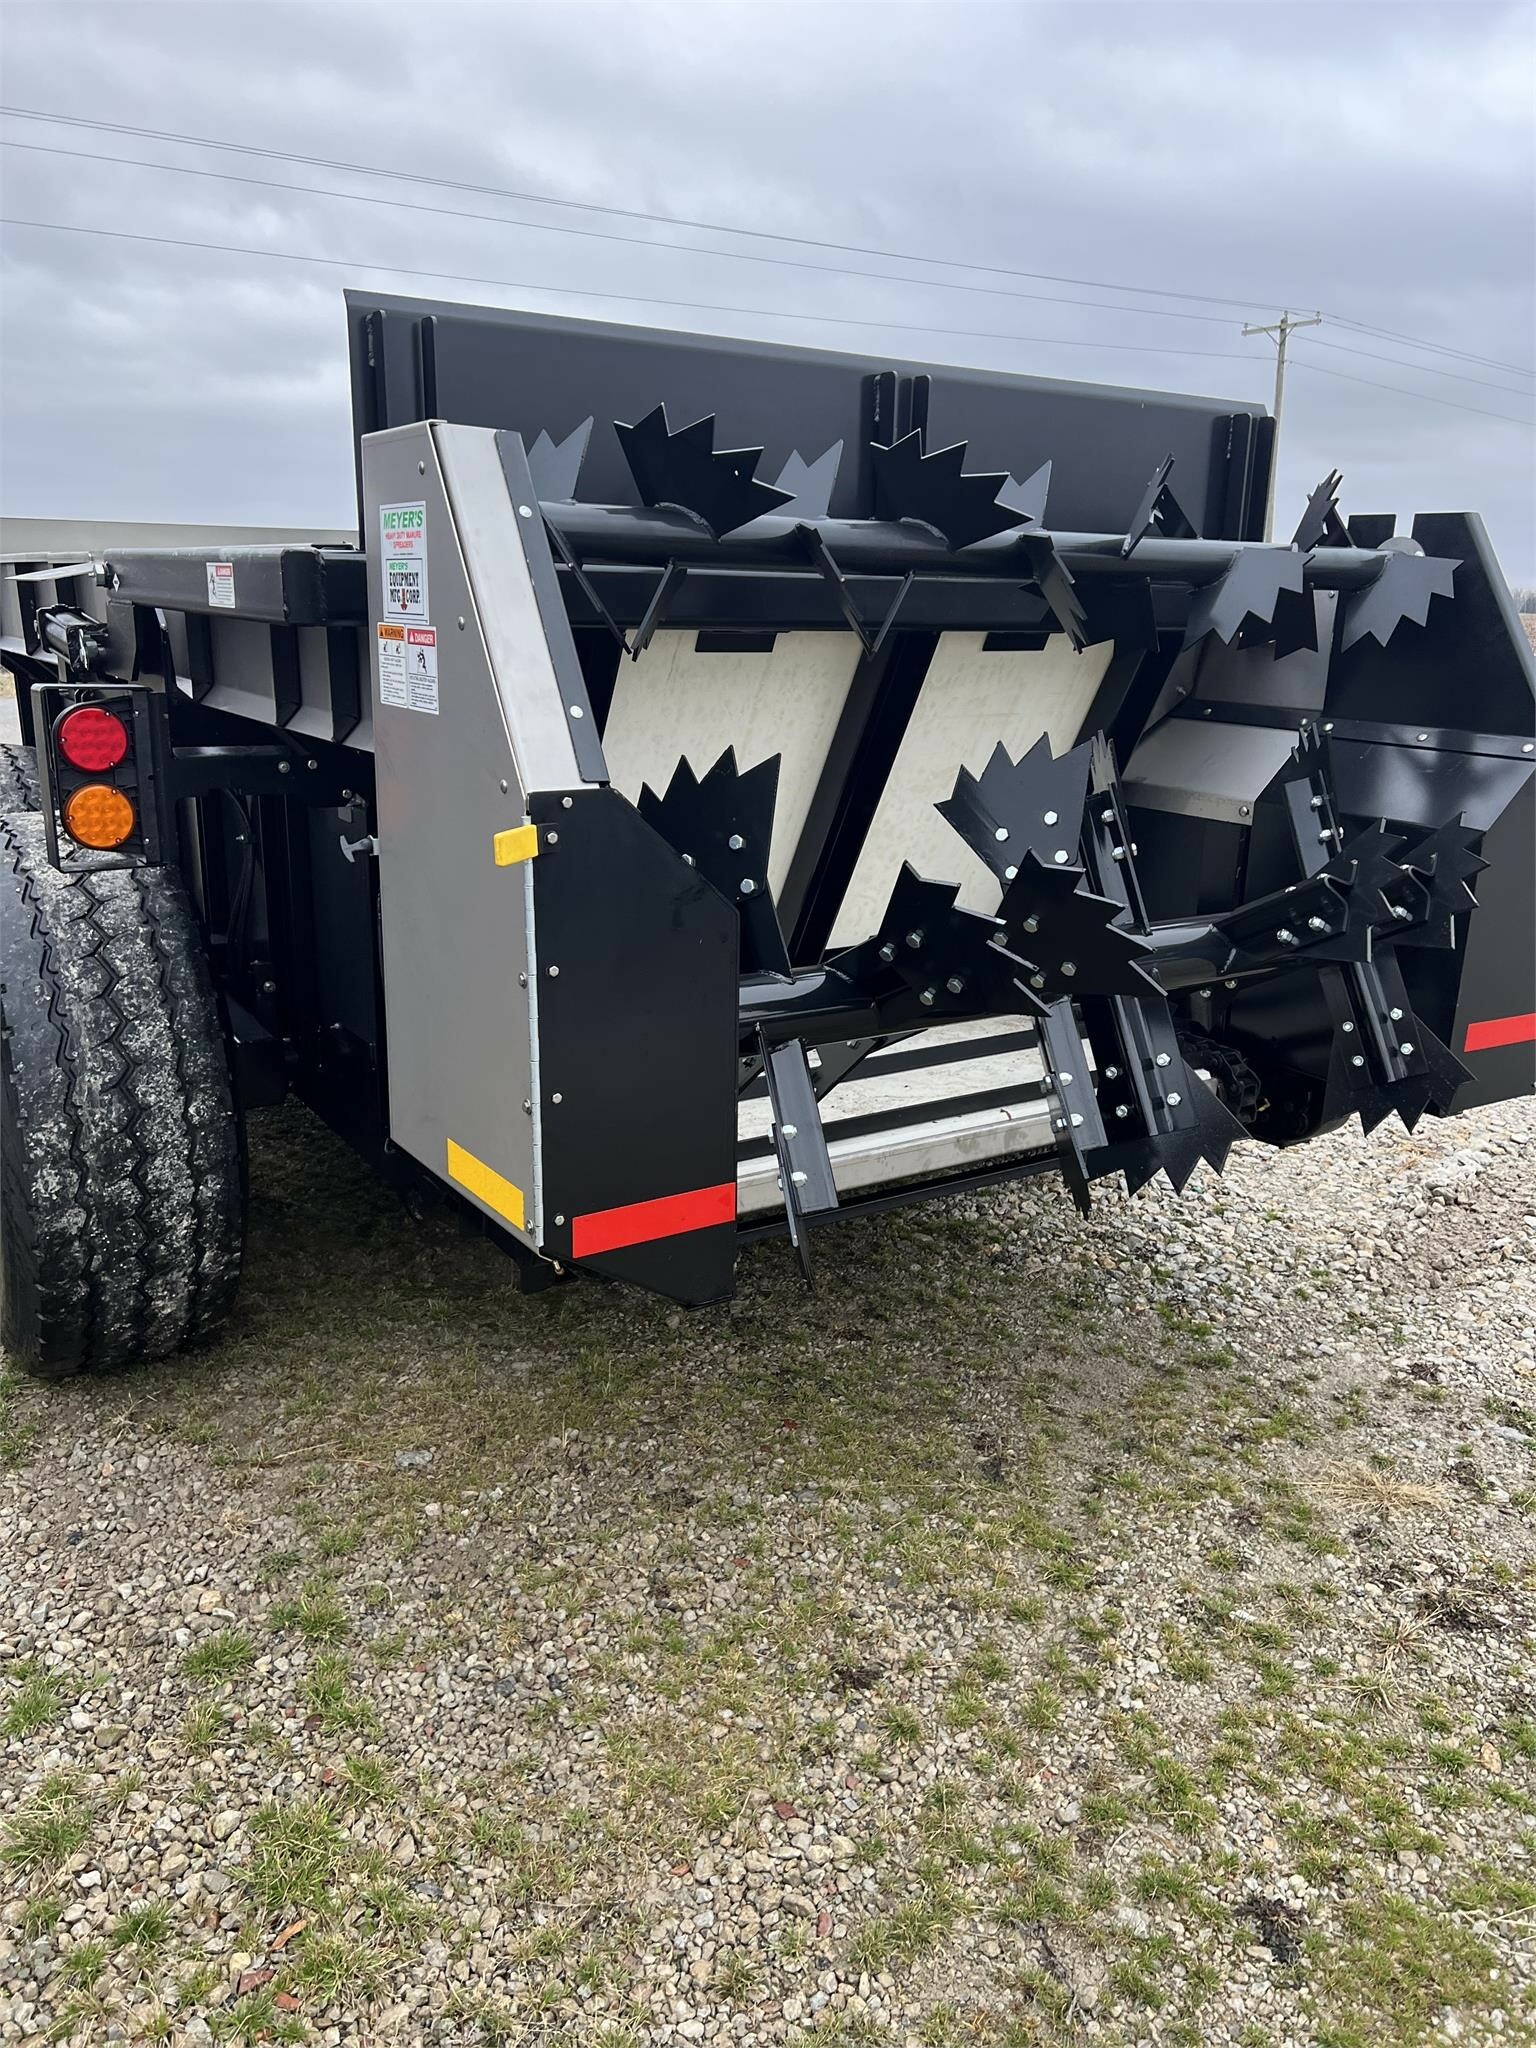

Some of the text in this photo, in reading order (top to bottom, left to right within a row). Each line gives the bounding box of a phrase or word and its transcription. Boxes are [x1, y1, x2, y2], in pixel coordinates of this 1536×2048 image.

[384, 510, 423, 529] MEYER'S
[389, 562, 408, 570] MEYER'S
[389, 572, 419, 587] EQUIPMENT
[384, 627, 404, 639] WARNING
[414, 633, 434, 645] DANGER
